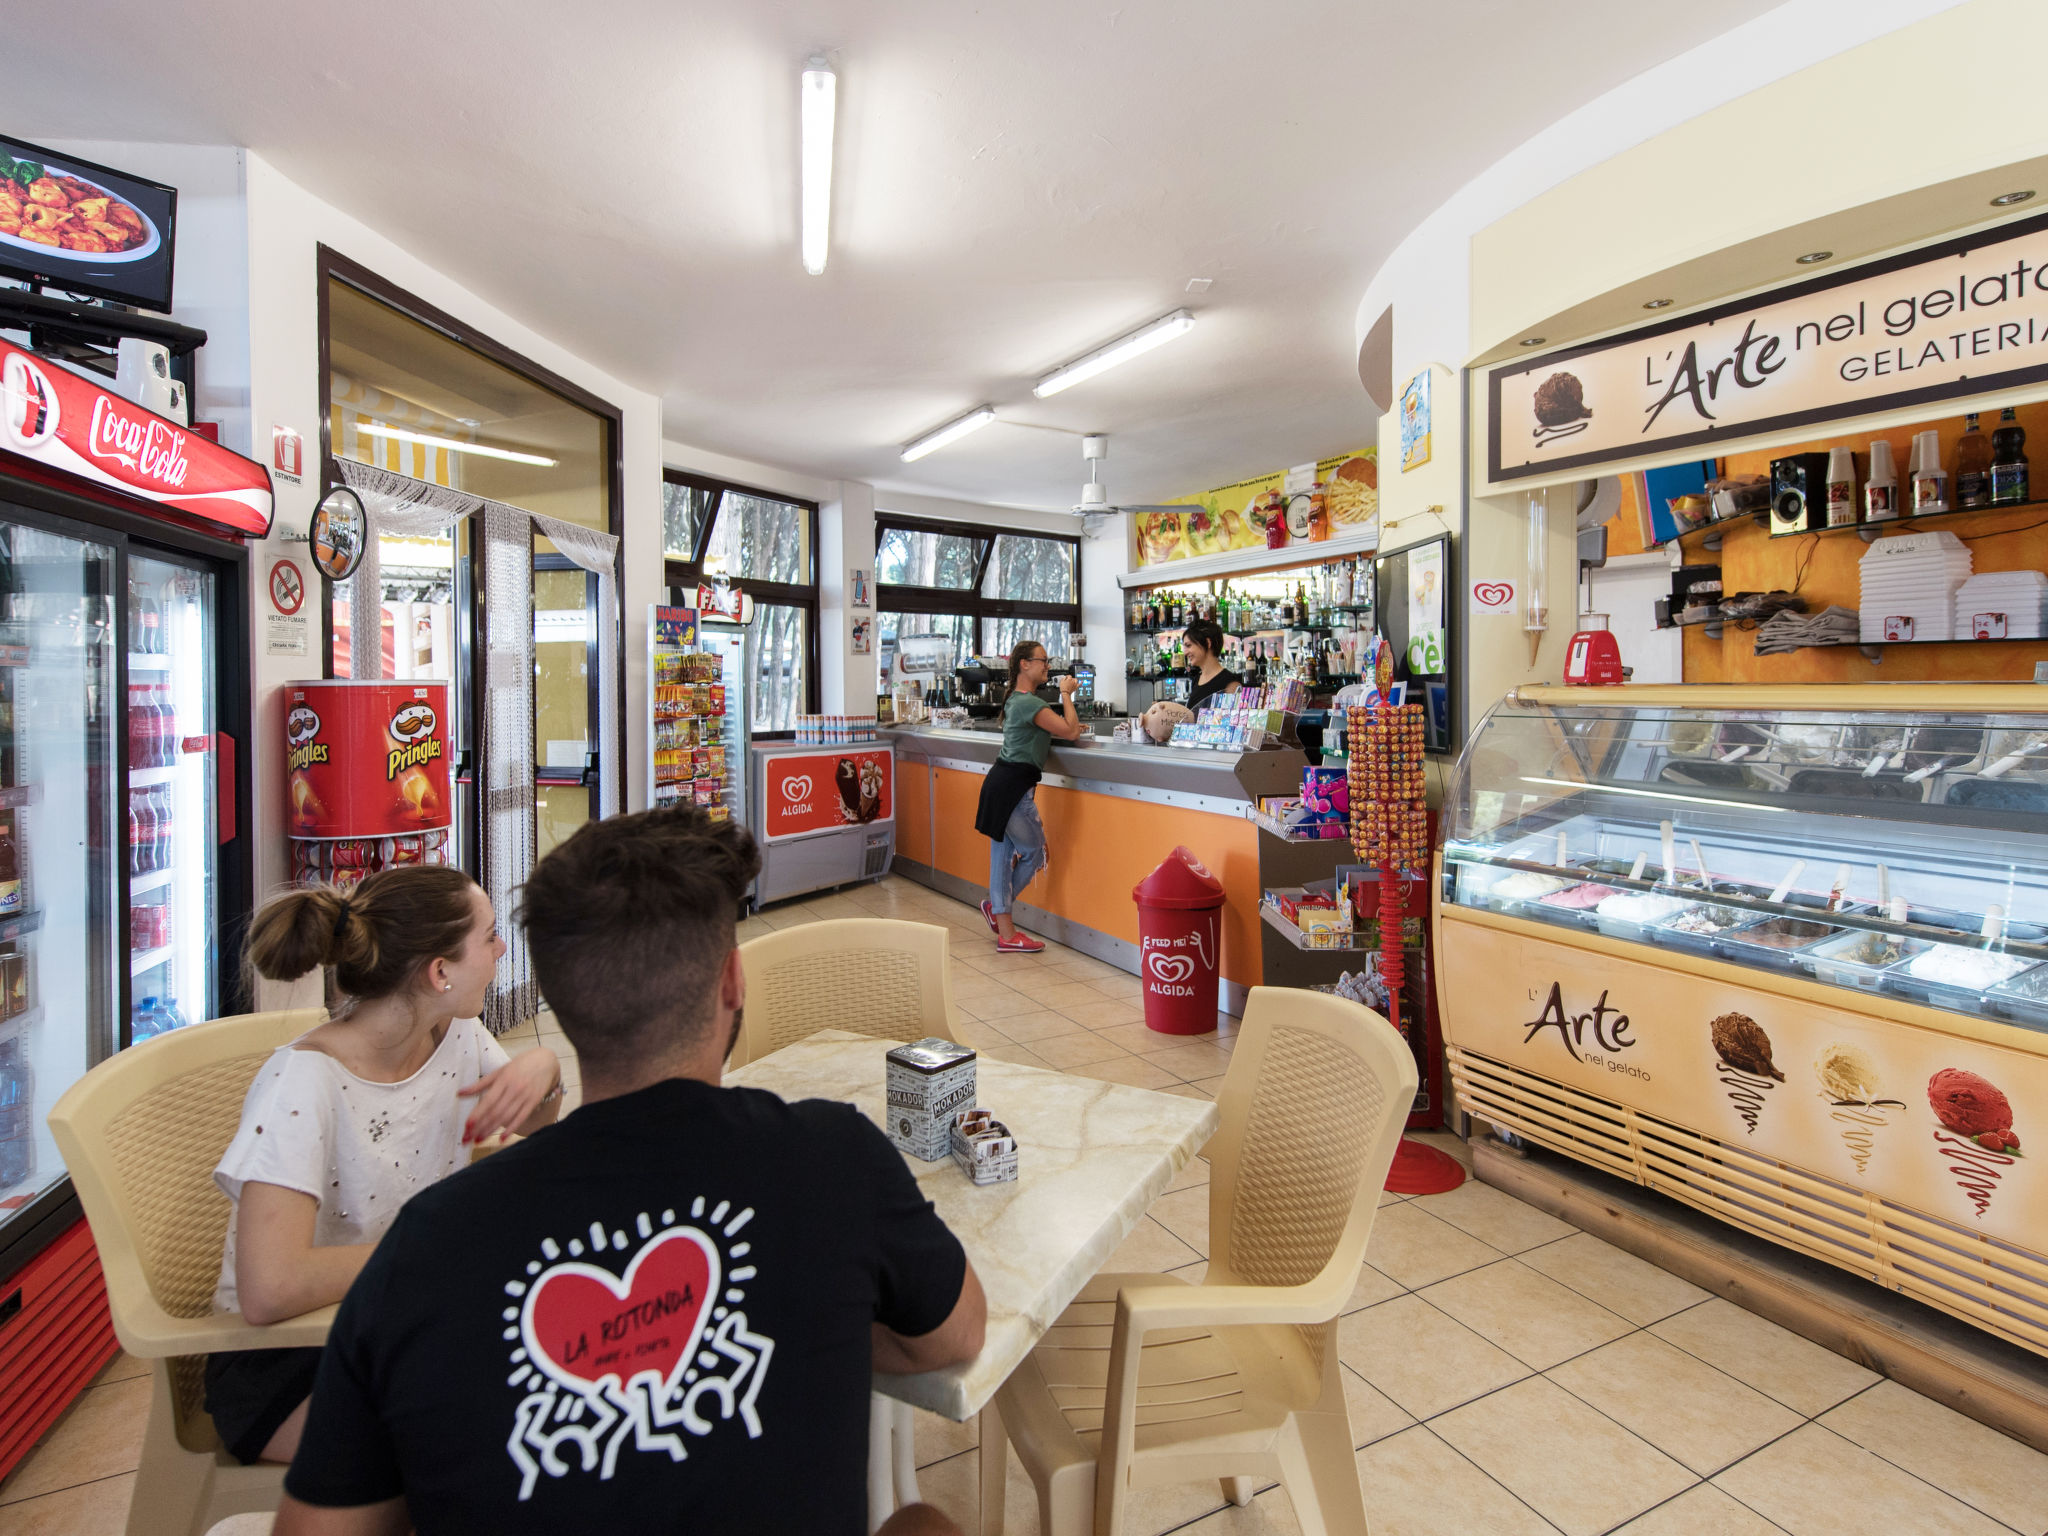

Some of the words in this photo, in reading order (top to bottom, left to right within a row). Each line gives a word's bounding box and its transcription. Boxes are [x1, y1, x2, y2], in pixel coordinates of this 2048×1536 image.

[1642, 319, 1786, 434] L'Arte
[1796, 301, 1865, 351] nel
[88, 394, 188, 489] Coca-Cola
[274, 471, 302, 485] ESTINTORE
[268, 614, 287, 622] VIETATO
[287, 616, 307, 624] FUMARE
[656, 606, 694, 623] HARIBO
[387, 735, 441, 781] Pringles
[781, 803, 813, 817] ALGIDA
[1151, 938, 1171, 948] FEED
[1173, 937, 1187, 947] ME!
[1150, 982, 1195, 997] ALGIDA
[1584, 1052, 1604, 1067] nel
[1607, 1060, 1651, 1081] gelato
[887, 1089, 924, 1108] MOKADOR
[933, 1080, 976, 1115] MOKADOR
[563, 1332, 589, 1365] LA
[601, 1282, 694, 1347] ROTONDA
